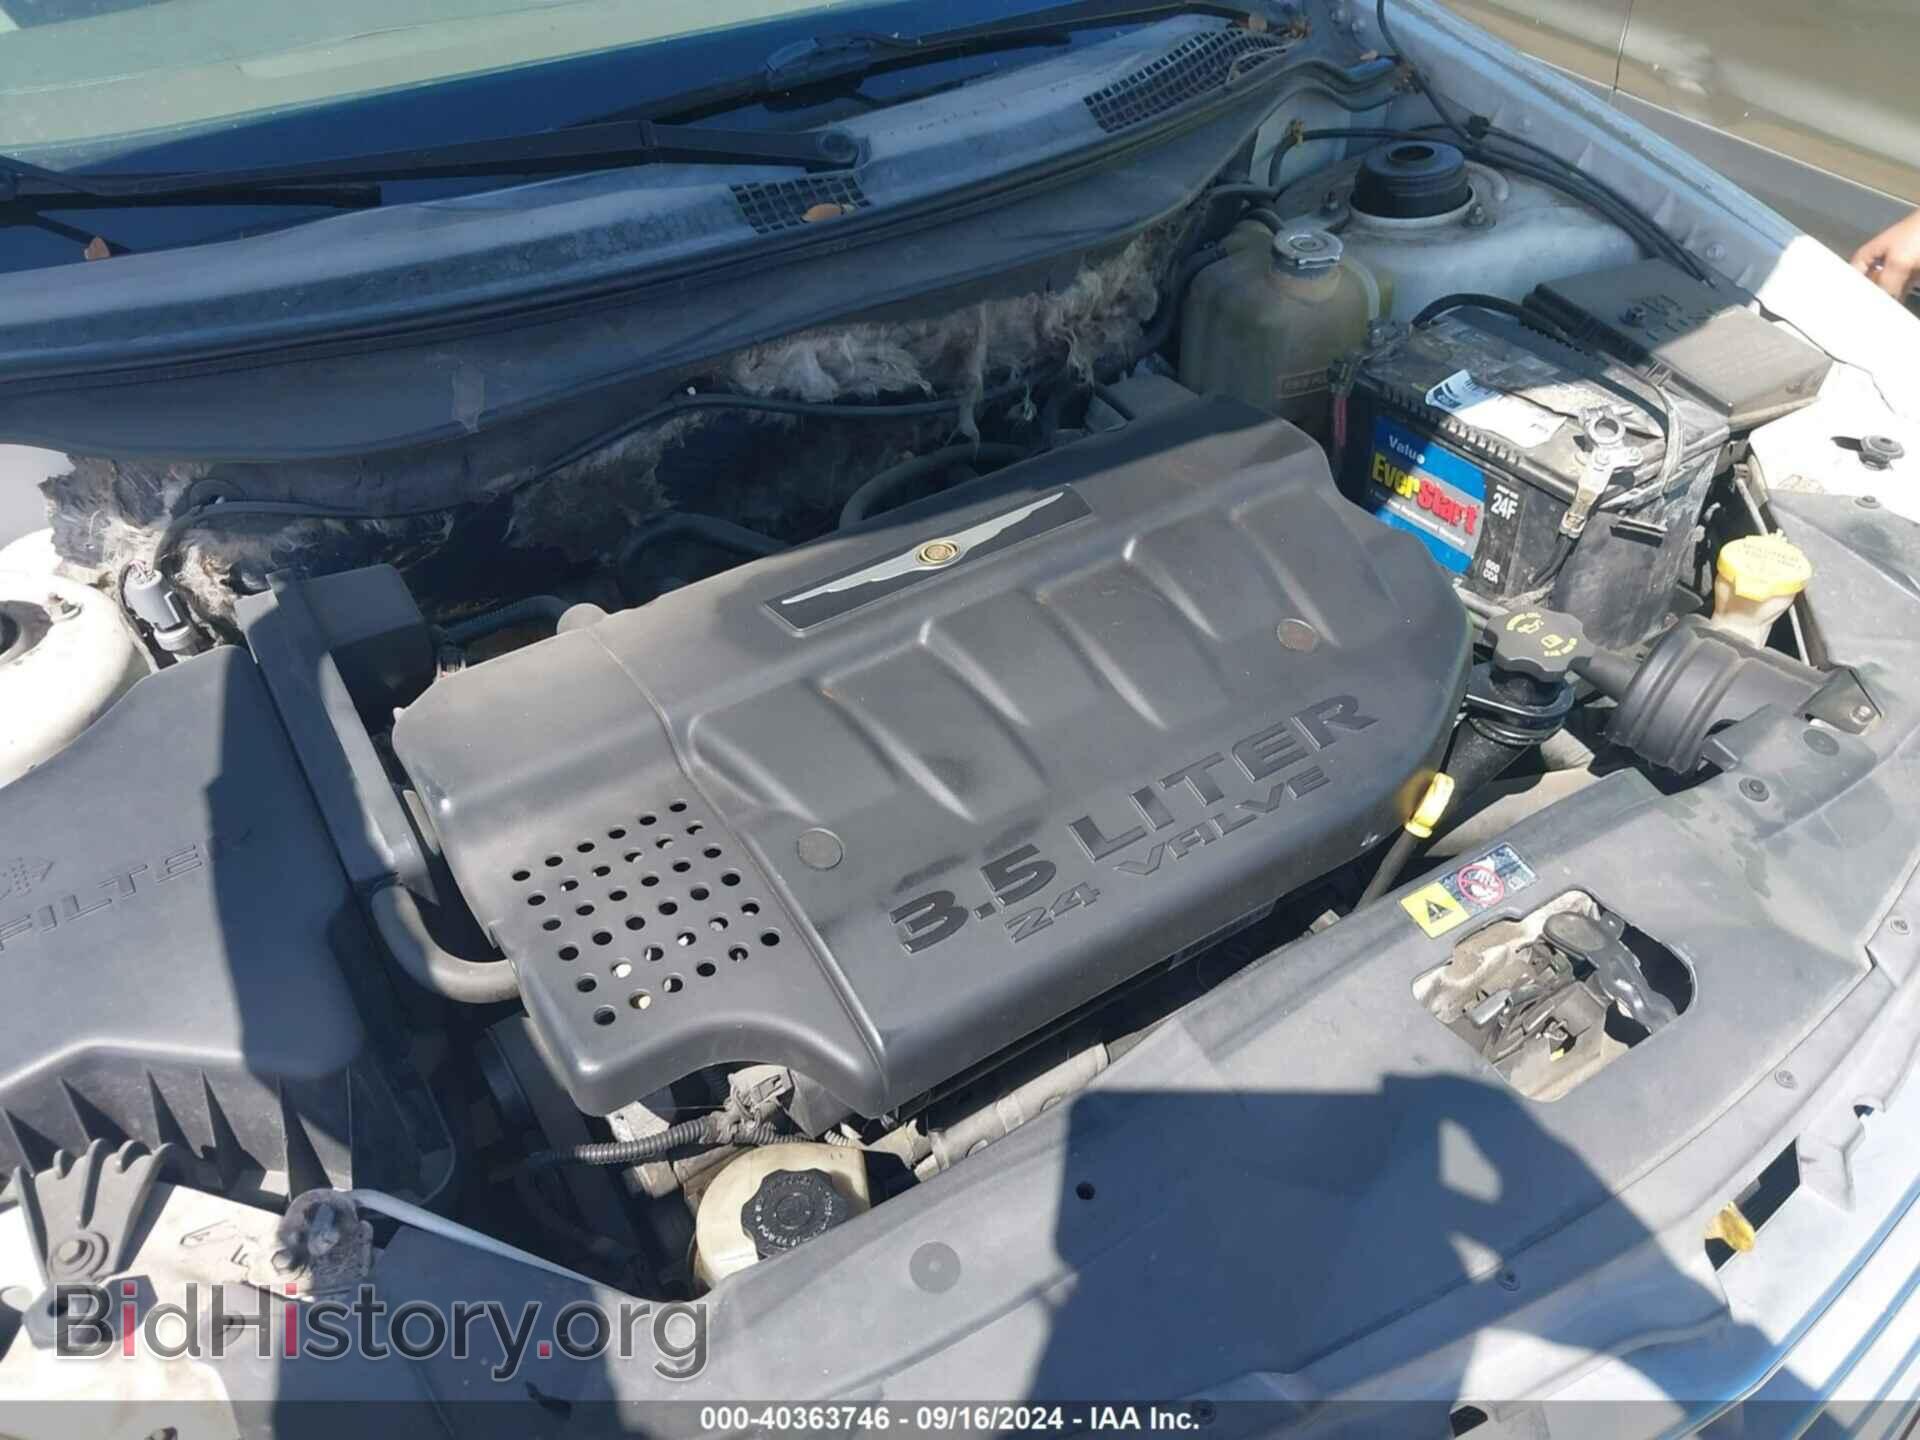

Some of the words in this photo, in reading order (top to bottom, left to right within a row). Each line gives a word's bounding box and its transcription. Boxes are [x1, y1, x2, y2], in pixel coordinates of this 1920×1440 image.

[1388, 434, 1426, 465] Value
[1371, 451, 1479, 537] EverStart
[1490, 492, 1519, 521] 24F
[888, 843, 1057, 954] 3.5
[1066, 694, 1380, 863] LITER
[1003, 881, 1101, 944] 24
[1112, 764, 1331, 876] VALVE
